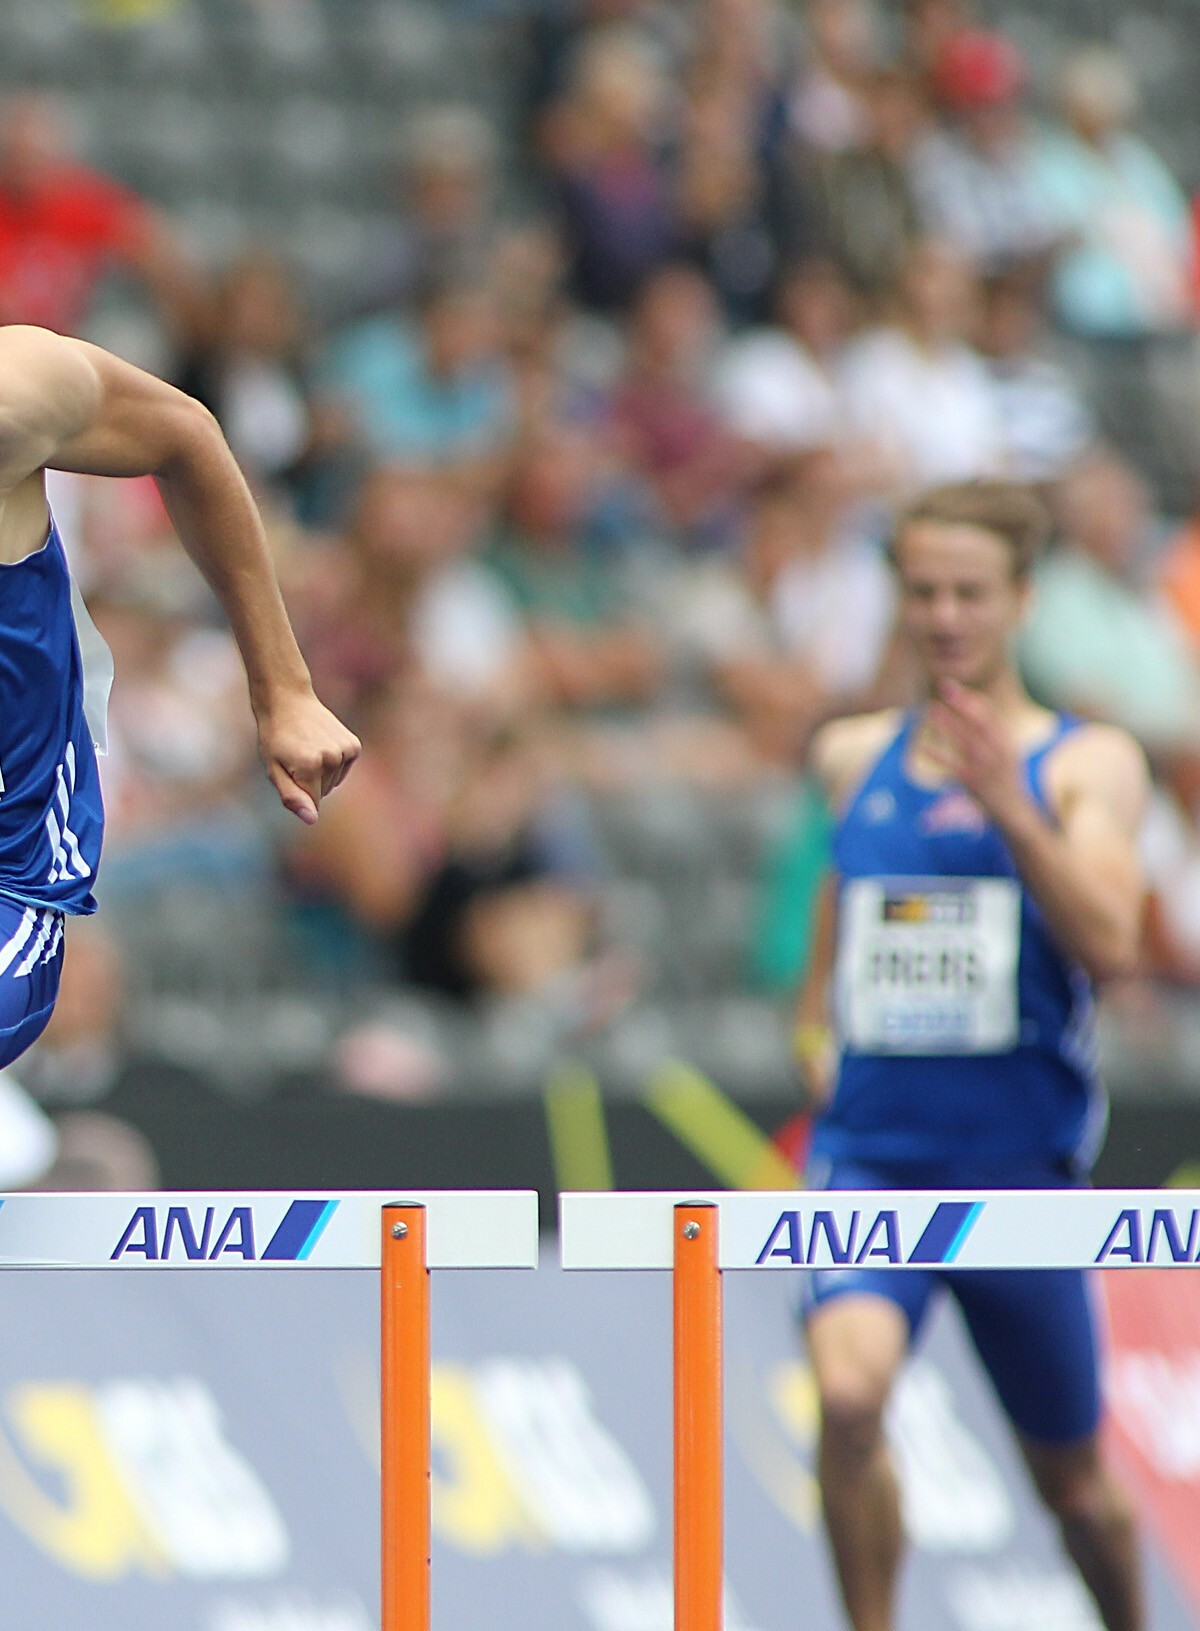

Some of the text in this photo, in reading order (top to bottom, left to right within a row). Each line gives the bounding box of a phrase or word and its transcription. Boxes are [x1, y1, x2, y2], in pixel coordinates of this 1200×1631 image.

[110, 1206, 257, 1261] ANA
[755, 1210, 903, 1265] ANA
[1094, 1208, 1200, 1264] AN
